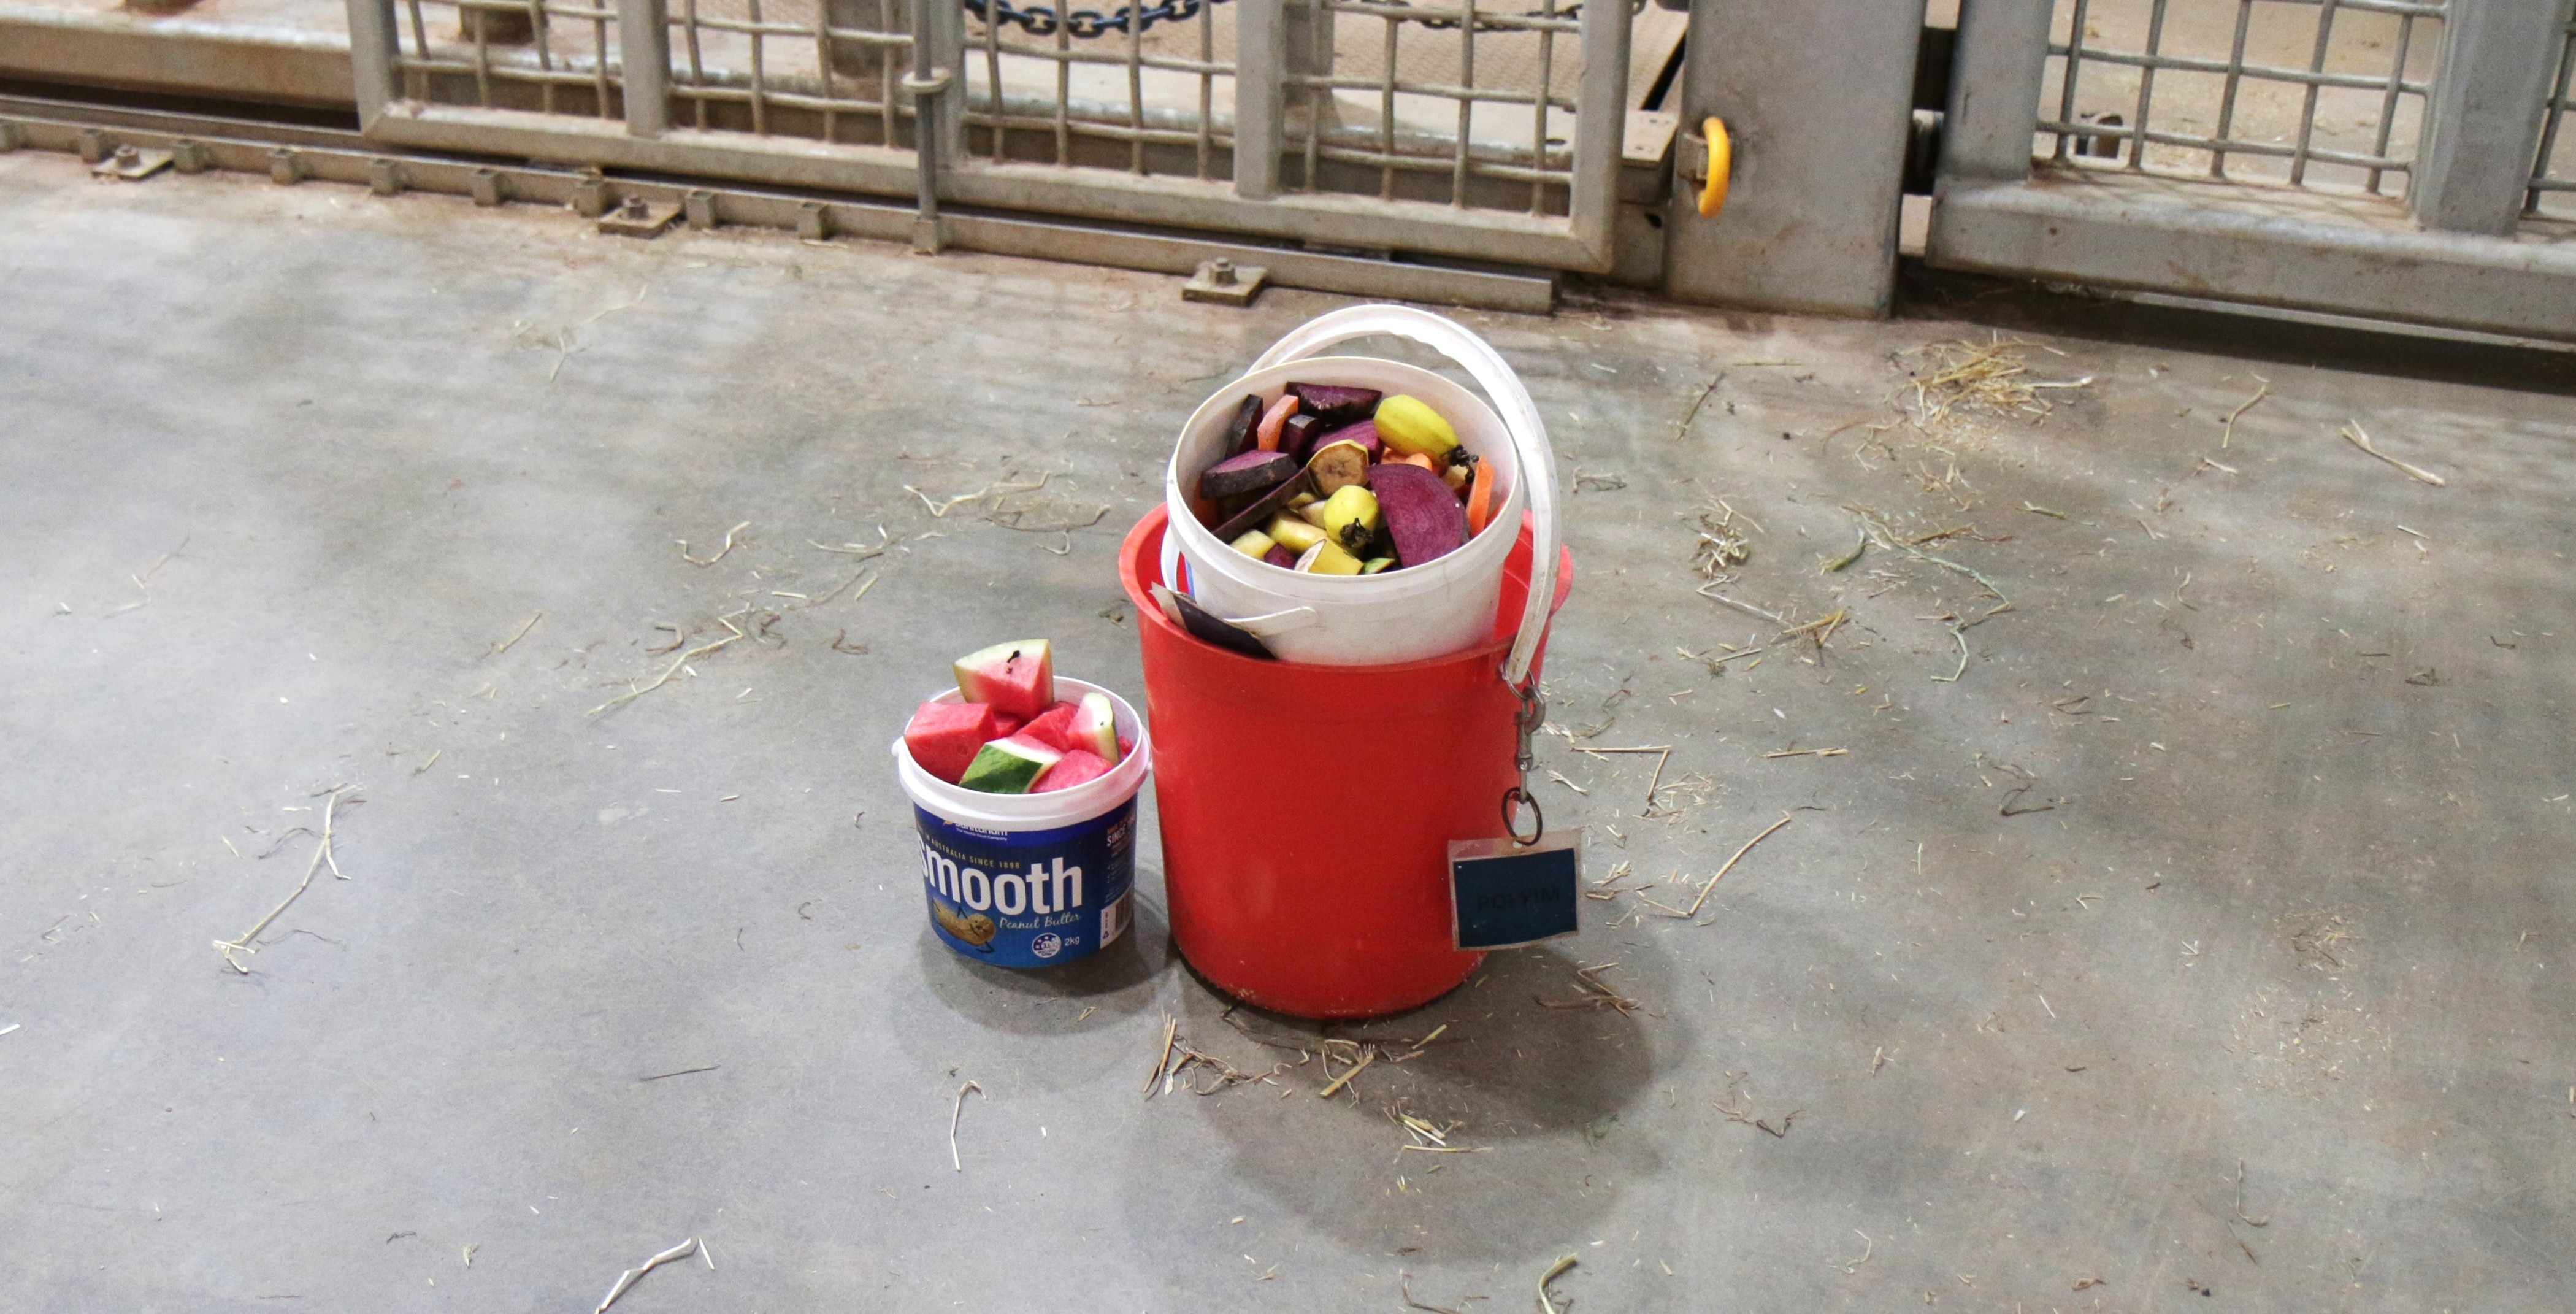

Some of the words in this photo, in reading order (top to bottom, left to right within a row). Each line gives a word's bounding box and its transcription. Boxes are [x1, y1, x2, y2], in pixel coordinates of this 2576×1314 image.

[931, 838, 967, 861] AUSTRALIA
[969, 856, 994, 867] SINCE
[918, 832, 1083, 916] smooth
[999, 916, 1041, 929] Peanut
[1045, 912, 1082, 928] Butter
[1064, 936, 1080, 947] 2kg
